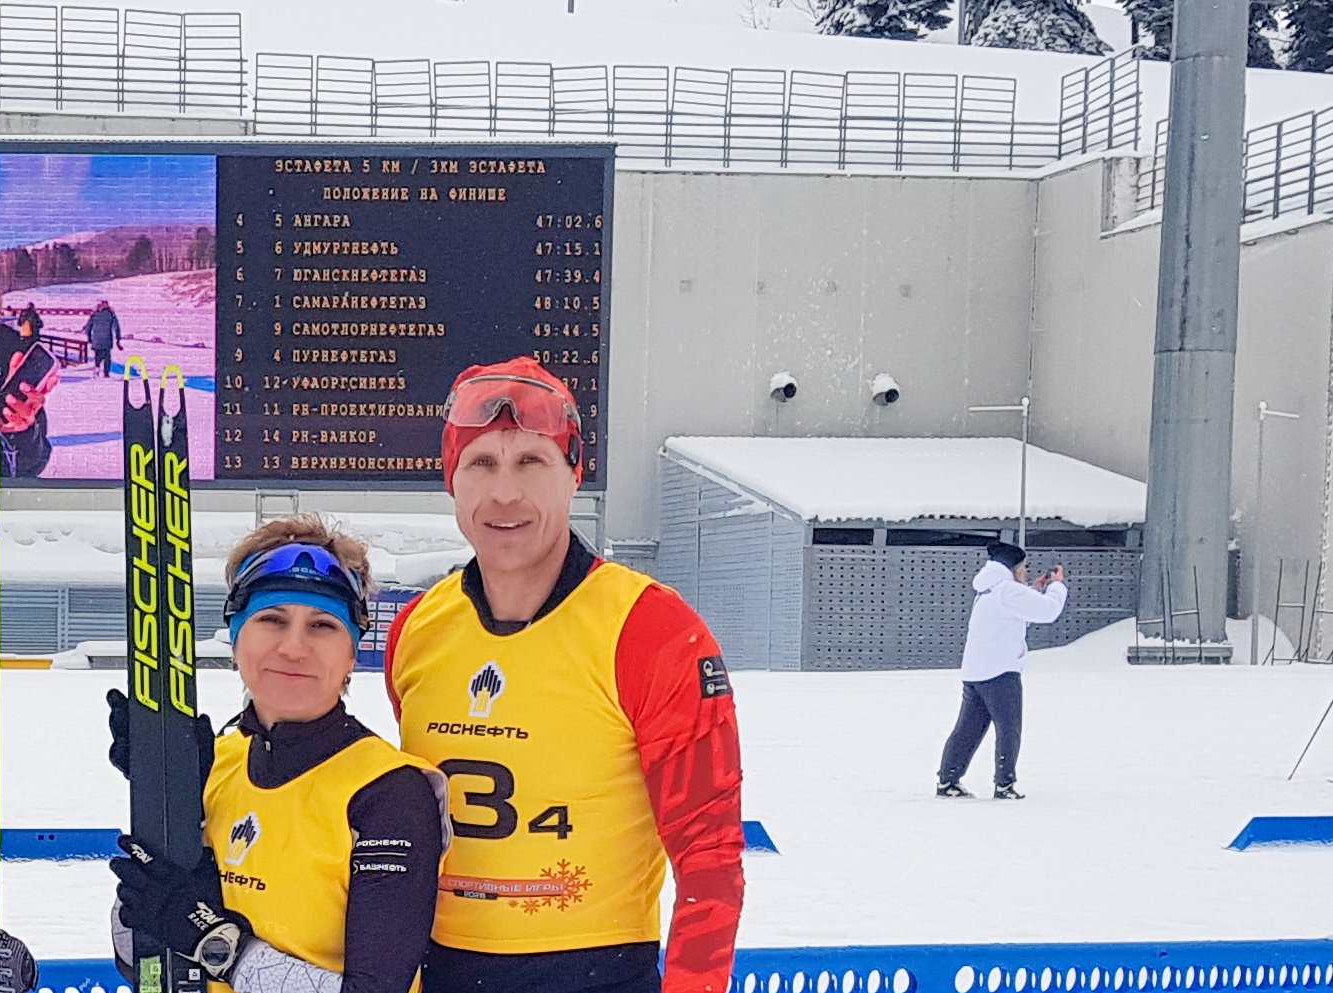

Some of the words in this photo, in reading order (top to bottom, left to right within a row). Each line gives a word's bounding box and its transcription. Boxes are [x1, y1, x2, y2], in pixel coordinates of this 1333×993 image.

[275, 160, 352, 173] ЭСТАФЕТА
[362, 160, 370, 173] 5
[382, 161, 401, 173] КМ
[430, 160, 459, 173] 3КМ
[469, 161, 547, 174] ЭСТАФЕТА
[323, 188, 409, 201] ПОЛОЖЕНИЕ
[420, 188, 439, 200] НА
[449, 188, 507, 201] ФИНИШЕ
[236, 214, 244, 227] 4
[274, 214, 283, 227] 5
[293, 214, 351, 227] АНГАРА
[536, 215, 603, 229] 47:02.6
[236, 241, 244, 254] 5
[274, 241, 283, 254] 6
[293, 241, 399, 256] УДМУРТНЕФТЬ
[535, 242, 601, 256] 47:15.1
[236, 268, 244, 281] 6
[274, 268, 283, 281] 7
[293, 268, 427, 283] ЮГАНСКНЕФТЕГАЗ
[535, 269, 601, 283] 47:39.4
[235, 295, 243, 307] 7
[274, 295, 282, 308] 1
[292, 296, 427, 309] САМАРАНЕФТЕГАЗ
[534, 296, 600, 310] 48:10.5
[235, 322, 243, 335] 8
[274, 322, 282, 335] 9
[292, 322, 446, 337] САМОТЛОРНЕФТЕГАЗ
[534, 323, 599, 337] 49:44.5
[235, 349, 243, 363] 9
[273, 349, 281, 363] 4
[292, 350, 398, 364] ПУРНЕФТЕГАЗ
[224, 376, 243, 389] 10
[264, 376, 280, 389] 12
[292, 376, 407, 390] УФАОРГСИНТЕЗ
[224, 403, 242, 416] 11
[263, 403, 280, 416] 11
[224, 429, 243, 442] 12
[263, 429, 280, 443] 14
[292, 430, 377, 443] РН-ВАНКОР
[224, 456, 242, 469] 13
[263, 456, 280, 469] 13
[130, 443, 159, 712] FISCHER
[164, 451, 195, 718] FISCHER
[426, 721, 529, 740] РОСНЕФТЬ
[437, 758, 519, 840] 3
[527, 804, 573, 840] 4
[355, 839, 412, 848] РОСНЕФТЬ
[447, 879, 522, 892] СПОРТИВНЫЕ
[525, 882, 564, 892] ИГРЫ
